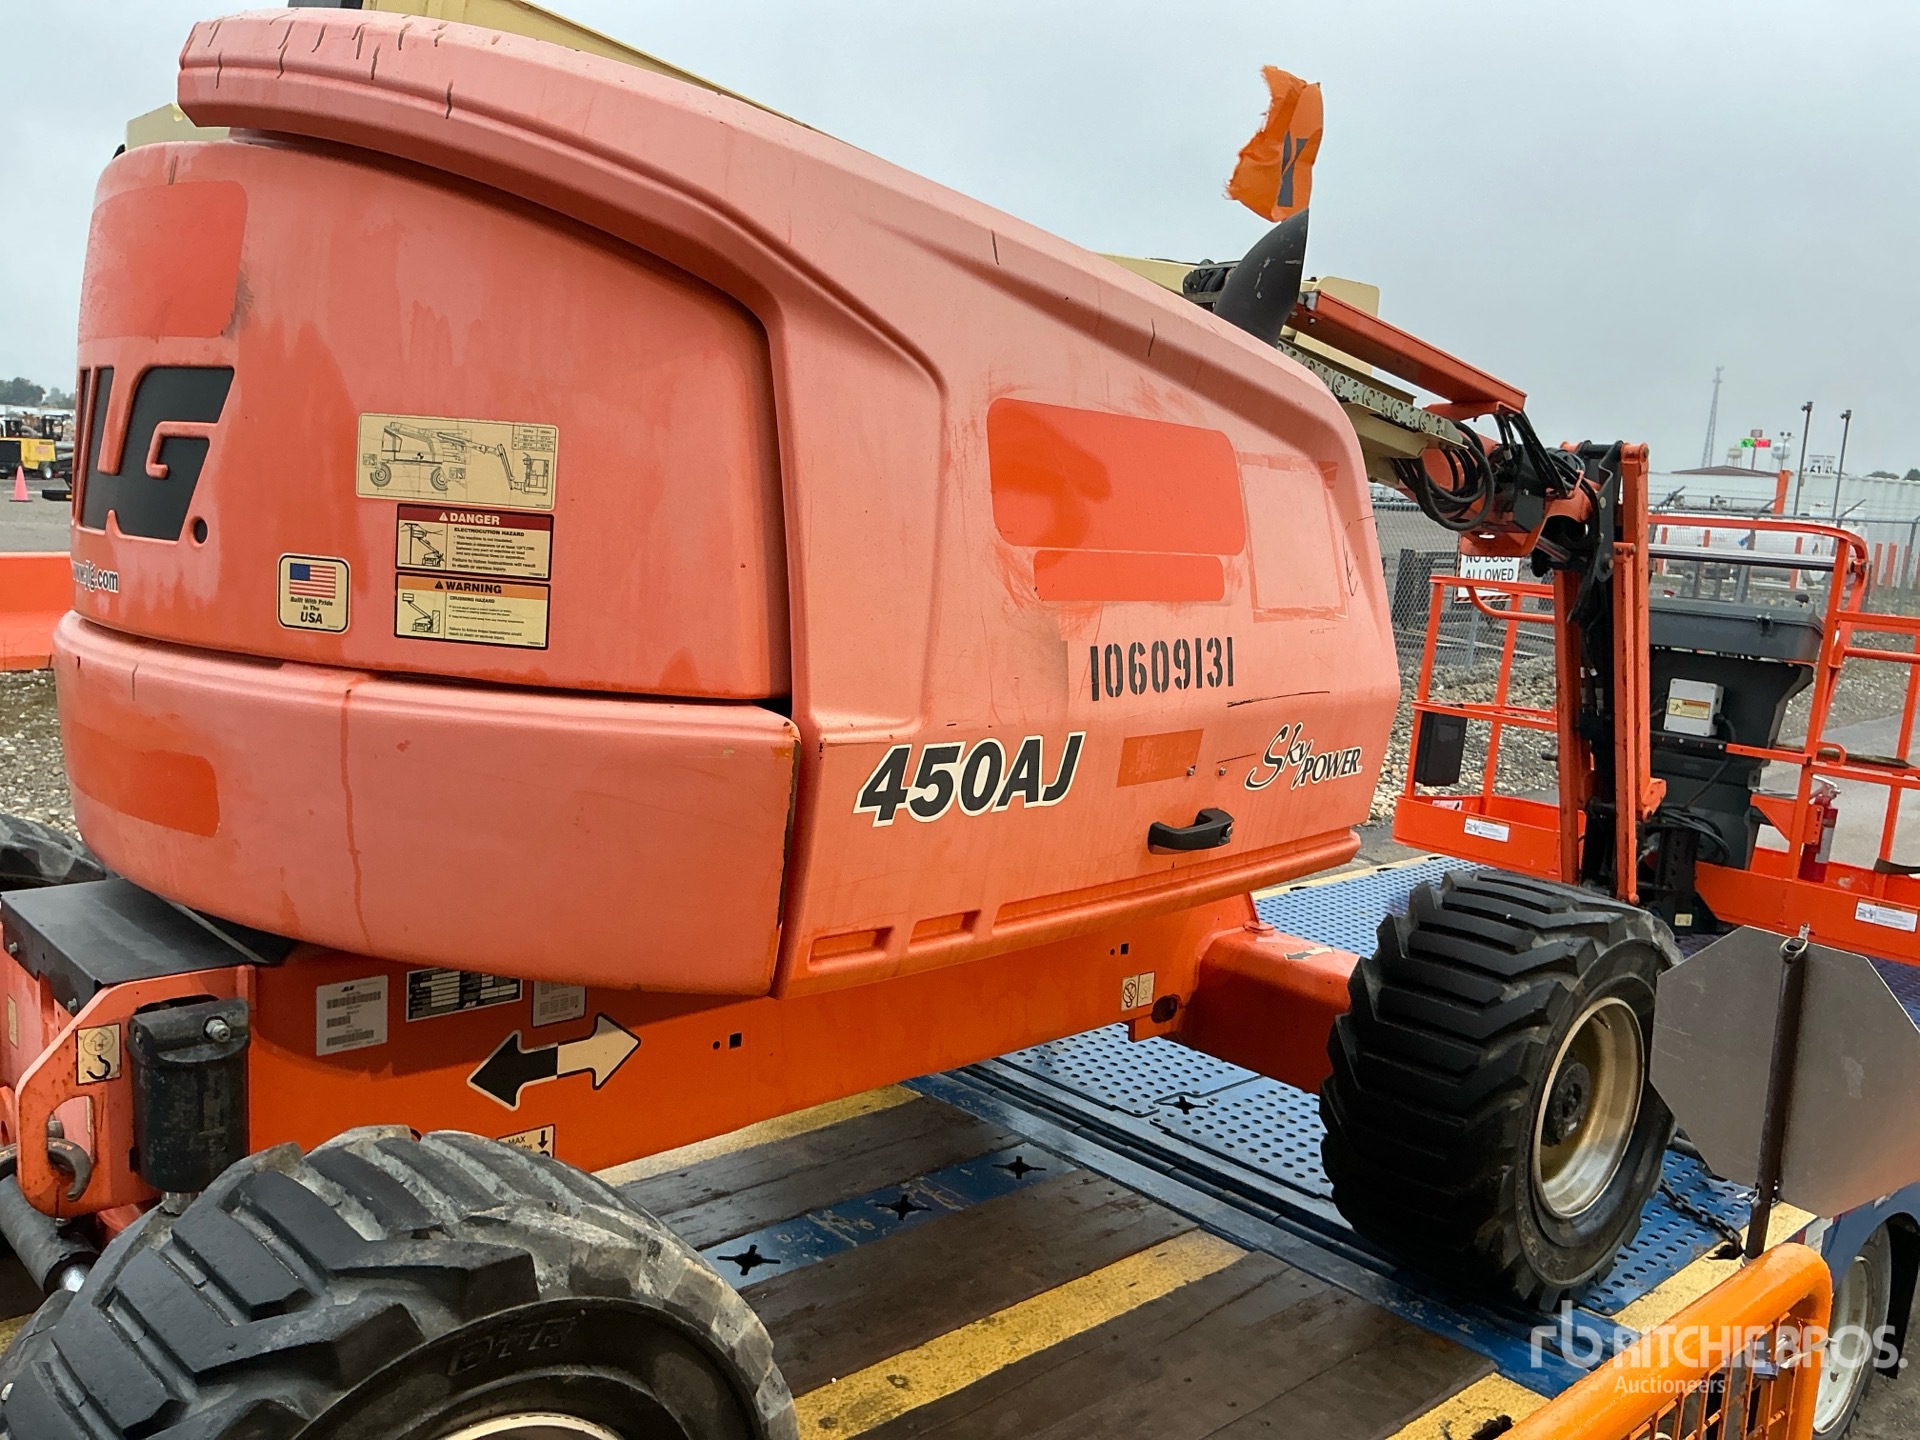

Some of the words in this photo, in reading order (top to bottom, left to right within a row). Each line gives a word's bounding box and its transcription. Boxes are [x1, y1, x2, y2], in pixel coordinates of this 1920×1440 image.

[450, 512, 500, 526] DANGER
[1466, 569, 1514, 581] ALLOWED
[446, 581, 502, 594] WARNING
[300, 611, 323, 624] USA
[1090, 636, 1234, 701] 10609131
[1244, 722, 1314, 790] Sky
[1298, 746, 1362, 786] POWER
[853, 731, 1086, 827] 450AJ
[508, 1136, 526, 1144] MAX
